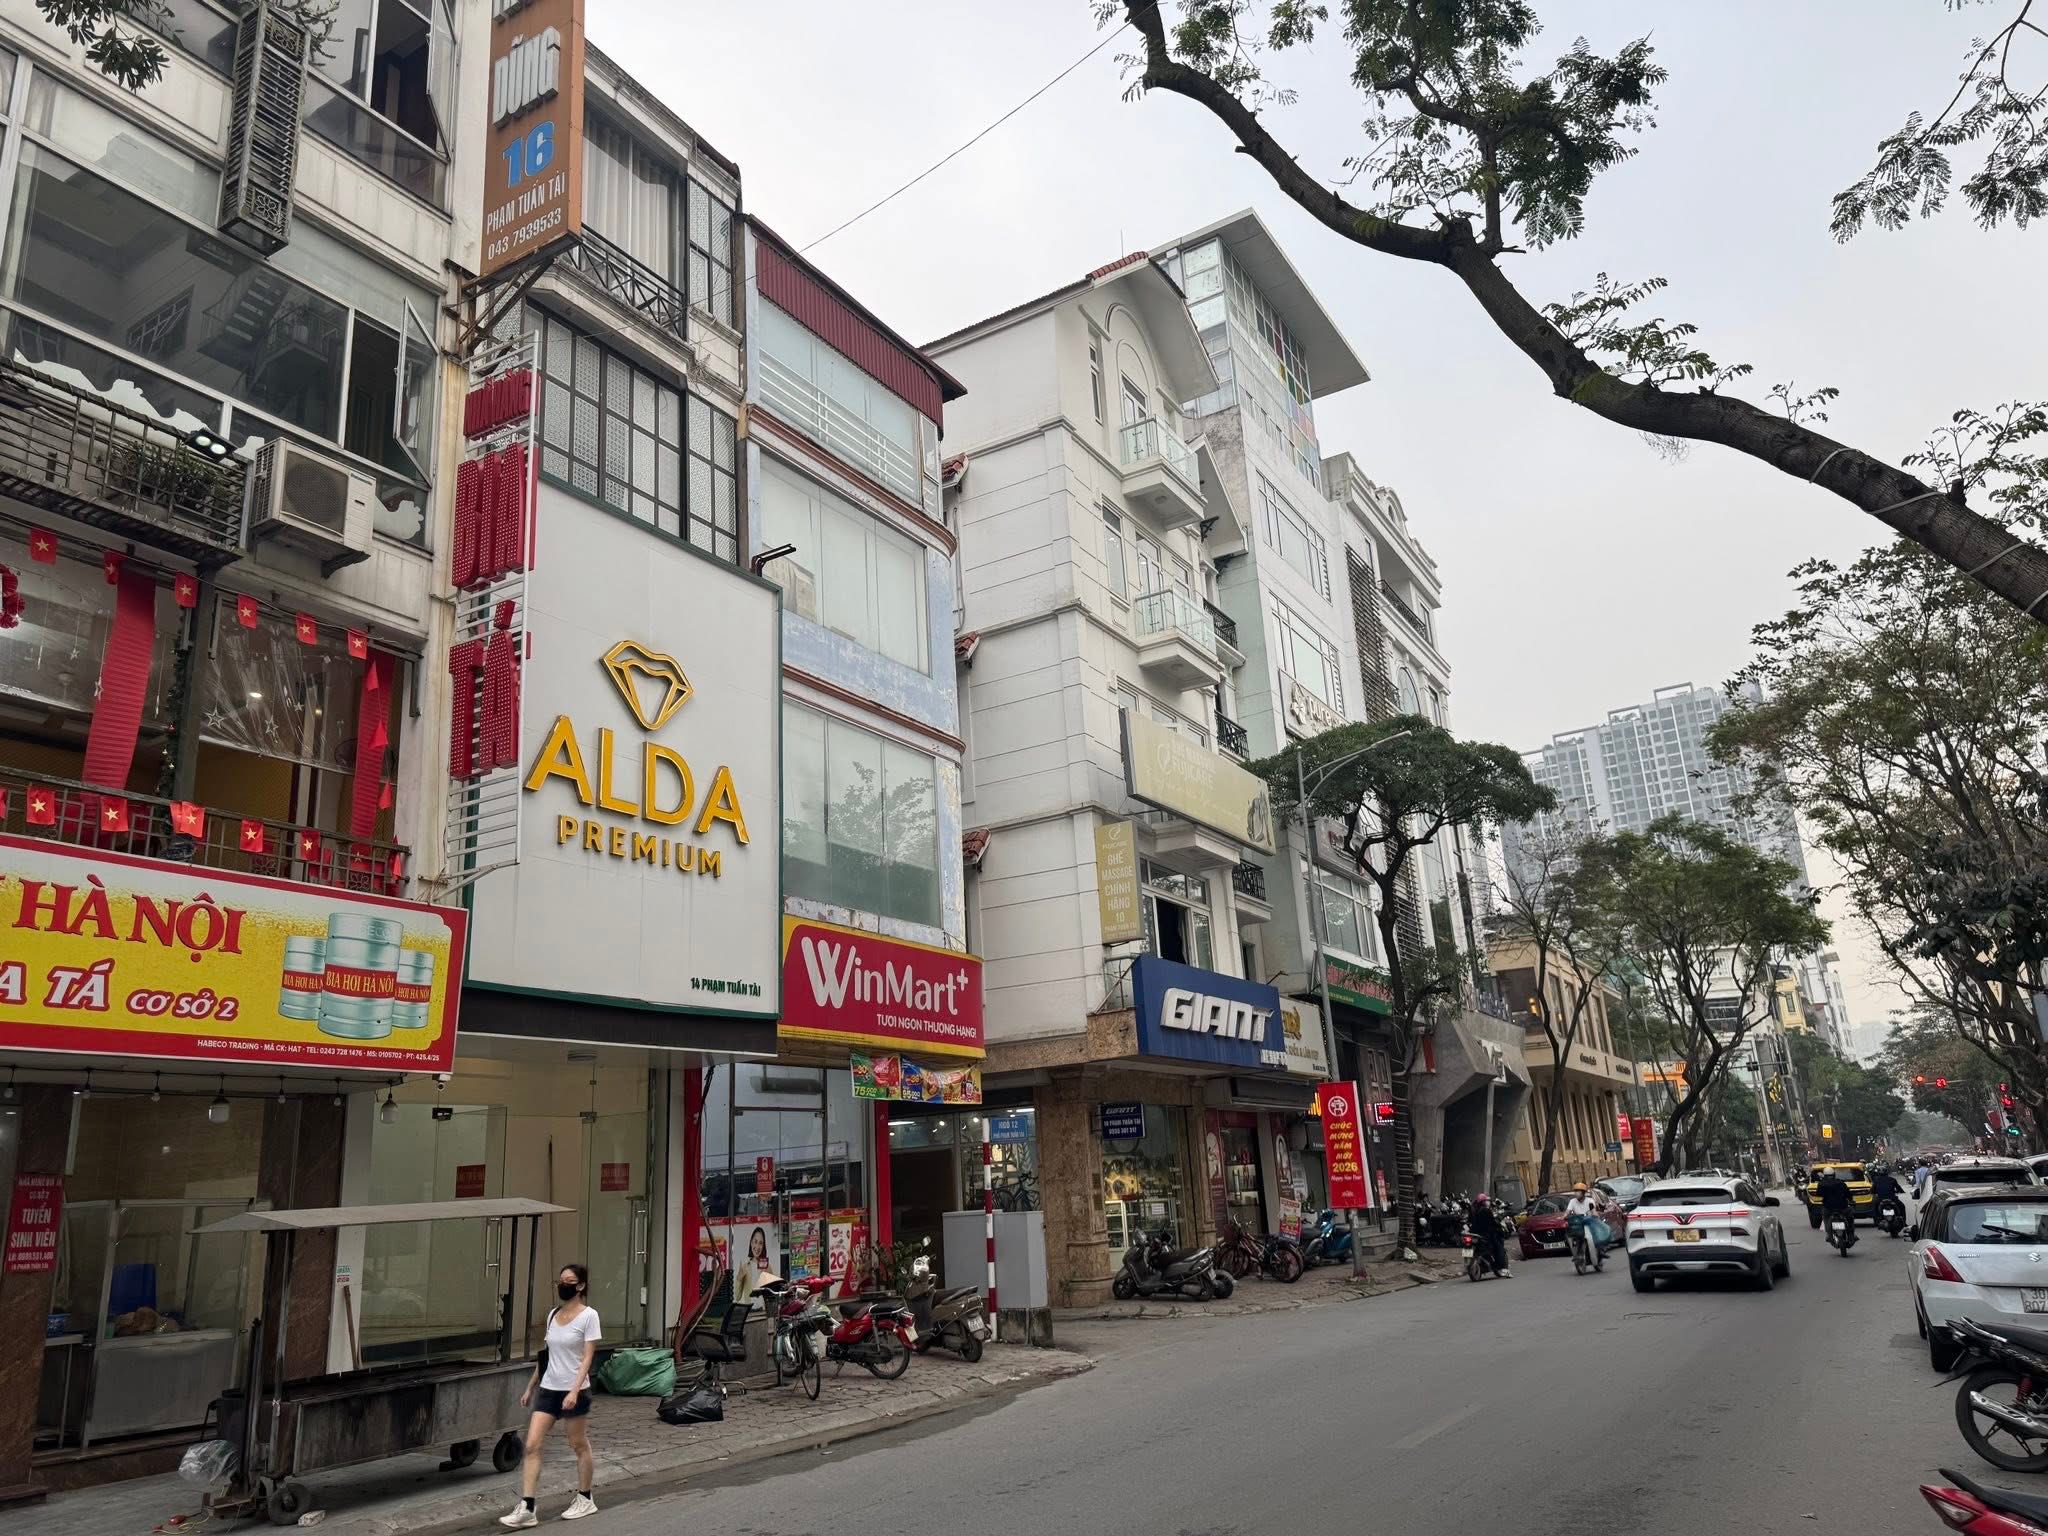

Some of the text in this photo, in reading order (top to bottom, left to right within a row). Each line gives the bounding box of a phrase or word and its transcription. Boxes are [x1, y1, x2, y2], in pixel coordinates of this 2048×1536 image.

[502, 120, 556, 189] 16
[487, 172, 565, 235] PHẠM TUẤN TÀI
[488, 207, 562, 260] 043 7939533
[452, 441, 527, 588] BIA
[524, 714, 750, 845] ALDA
[558, 814, 722, 878] PREMIUM
[12, 873, 247, 963] HÀ NỘI
[44, 958, 115, 1010] TÁ
[216, 999, 239, 1020] 2
[326, 971, 340, 988] BIA
[363, 973, 376, 993] HÀ
[691, 977, 761, 997] 14 PHẠM TUẤN TÀI
[898, 1017, 923, 1031] NGON
[1160, 988, 1274, 1042] GIANT
[197, 1040, 227, 1048] HABECO
[228, 1041, 259, 1050] TRADING
[306, 1046, 319, 1054] TEL:
[1332, 1162, 1358, 1173] 2026
[11, 1228, 56, 1248] SINH VIÊN
